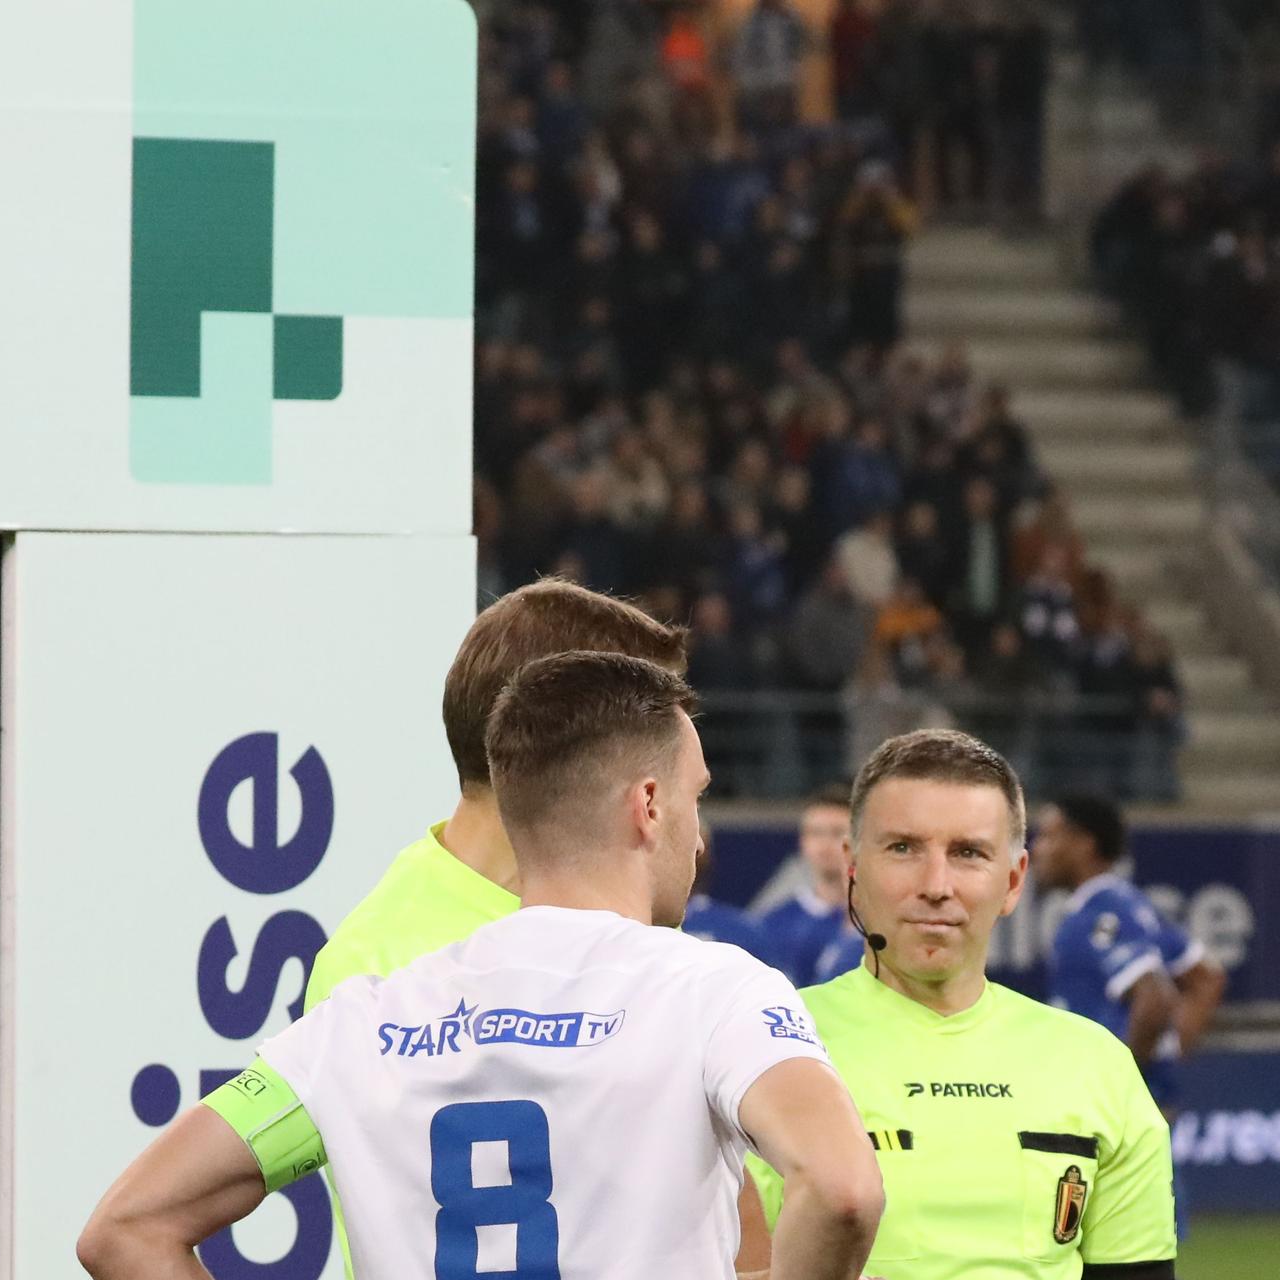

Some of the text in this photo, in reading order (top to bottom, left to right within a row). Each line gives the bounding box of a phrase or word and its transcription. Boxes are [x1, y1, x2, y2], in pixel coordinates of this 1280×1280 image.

[378, 1014, 619, 1057] STAR SPORT TV
[931, 1082, 1013, 1098] PATRICK
